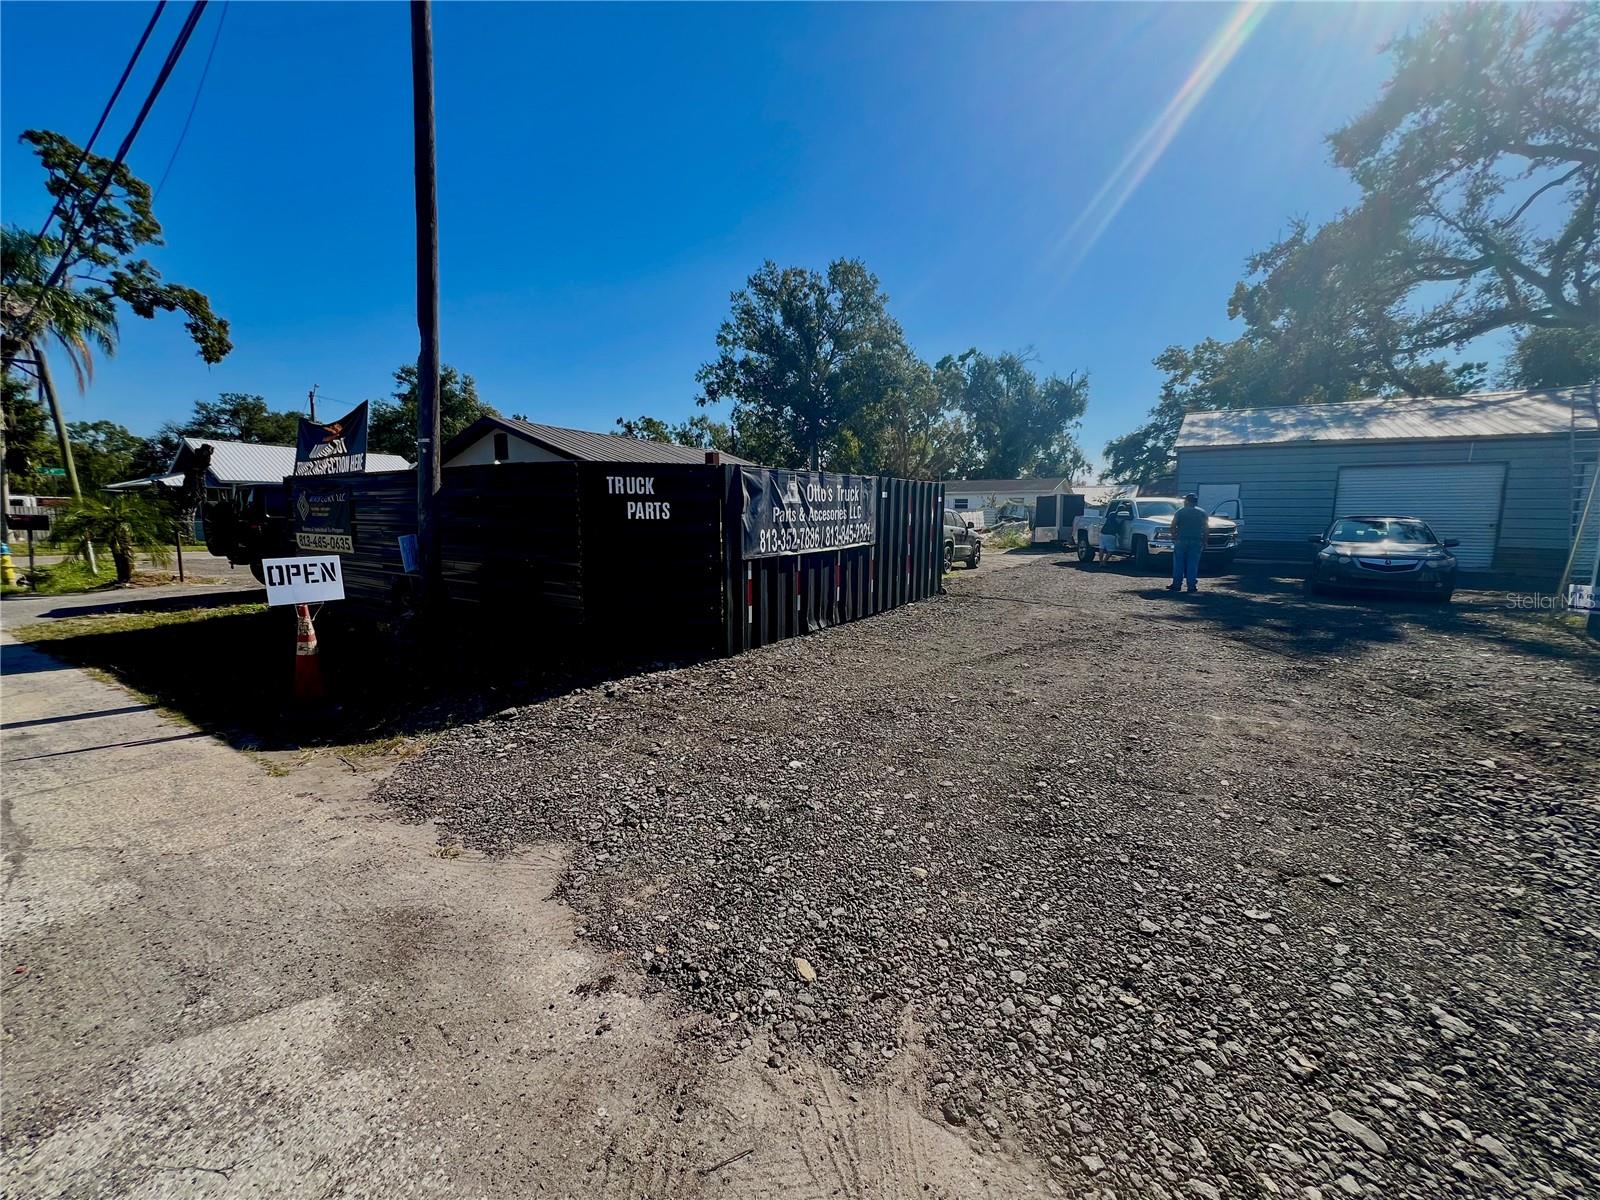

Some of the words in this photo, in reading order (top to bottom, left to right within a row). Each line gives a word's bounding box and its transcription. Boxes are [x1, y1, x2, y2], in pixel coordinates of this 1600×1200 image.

[349, 452, 365, 473] HERE
[606, 476, 655, 494] TRUCK
[806, 483, 833, 502] Otto's
[837, 484, 860, 502] Truck
[627, 501, 670, 519] PARTS
[772, 506, 797, 522] Parts
[799, 506, 806, 522] &
[808, 506, 847, 521] Accesories
[849, 505, 862, 519] LLC
[298, 534, 351, 550] 813-485-0635
[760, 526, 820, 553] 813-352-7886
[267, 562, 337, 586] OPEN
